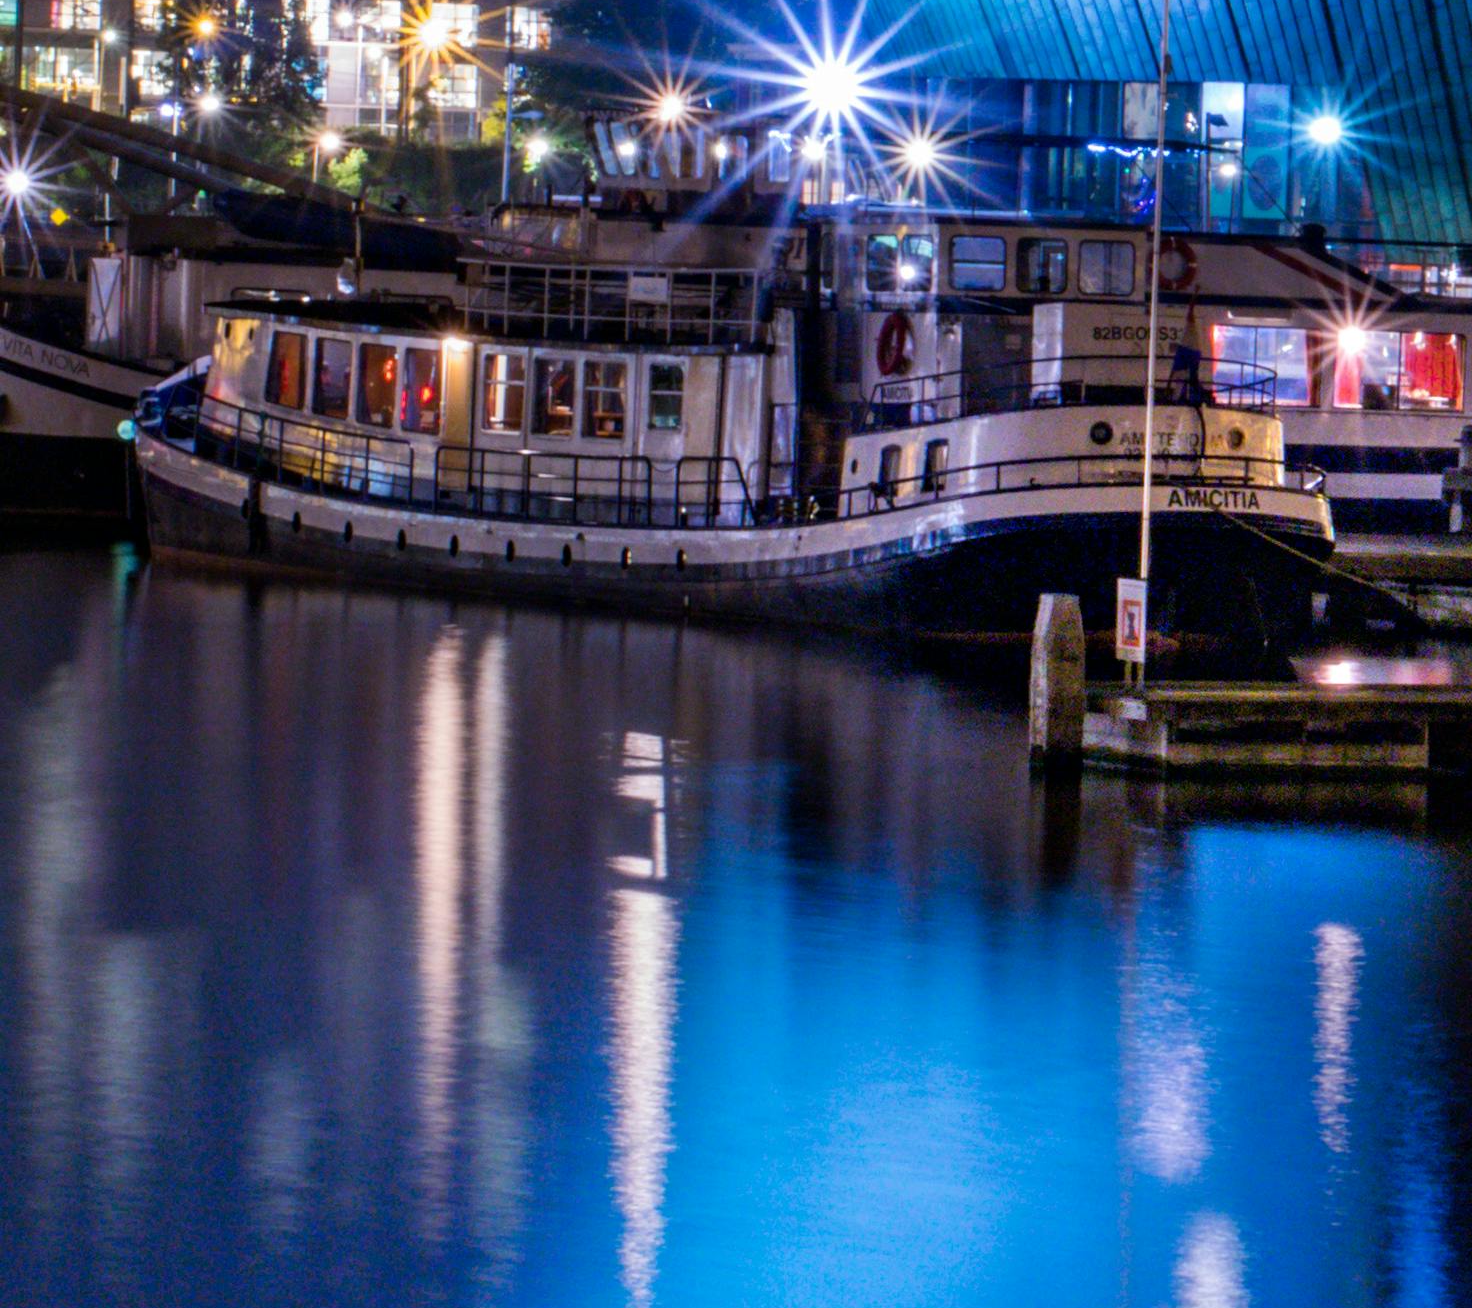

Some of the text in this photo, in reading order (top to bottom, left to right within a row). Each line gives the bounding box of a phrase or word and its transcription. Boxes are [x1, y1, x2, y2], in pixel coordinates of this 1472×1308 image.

[3, 336, 90, 378] VITA NOVA
[1168, 490, 1260, 509] AMICITIA
